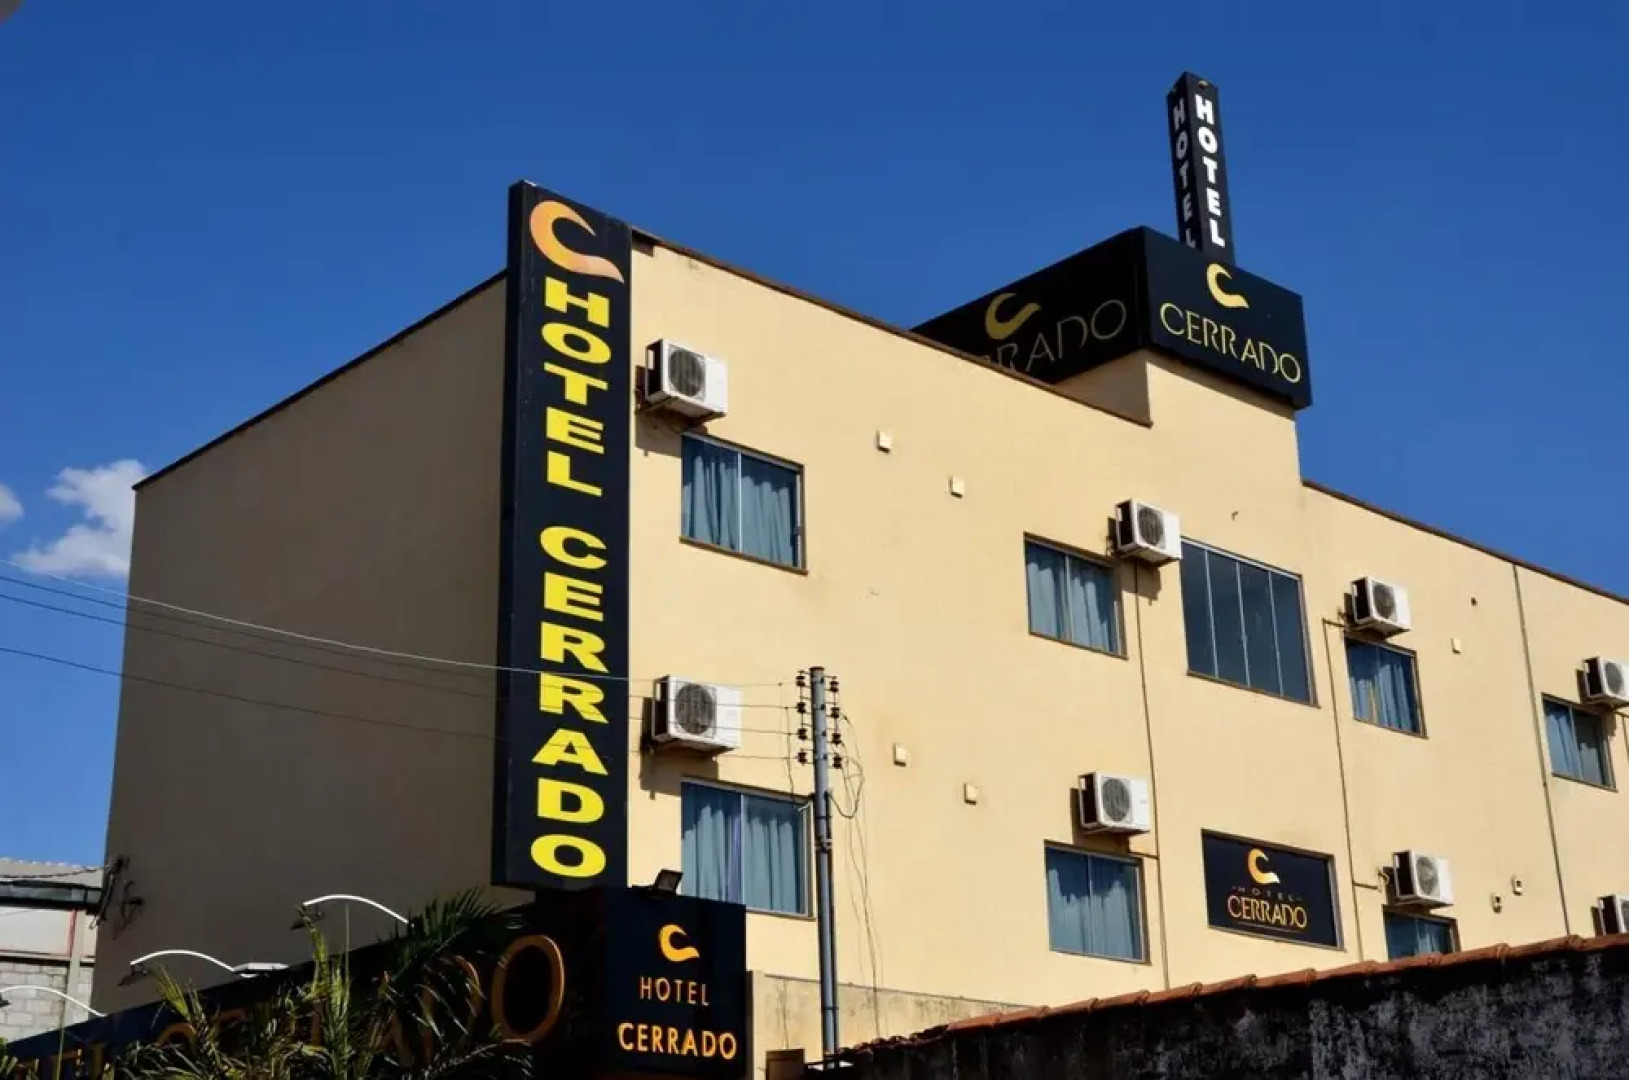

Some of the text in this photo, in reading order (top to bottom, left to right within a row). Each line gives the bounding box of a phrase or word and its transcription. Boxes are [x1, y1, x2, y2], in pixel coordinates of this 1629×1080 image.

[1172, 97, 1197, 248] HOTEL
[1194, 93, 1226, 249] HOTEL
[979, 298, 1127, 373] RADO
[1159, 302, 1301, 385] CERRADO
[531, 276, 612, 879] HOTEL CERRADO
[1227, 895, 1308, 929] CERRADO
[639, 975, 710, 1006] HOTEL
[617, 1022, 738, 1060] CERRADO
